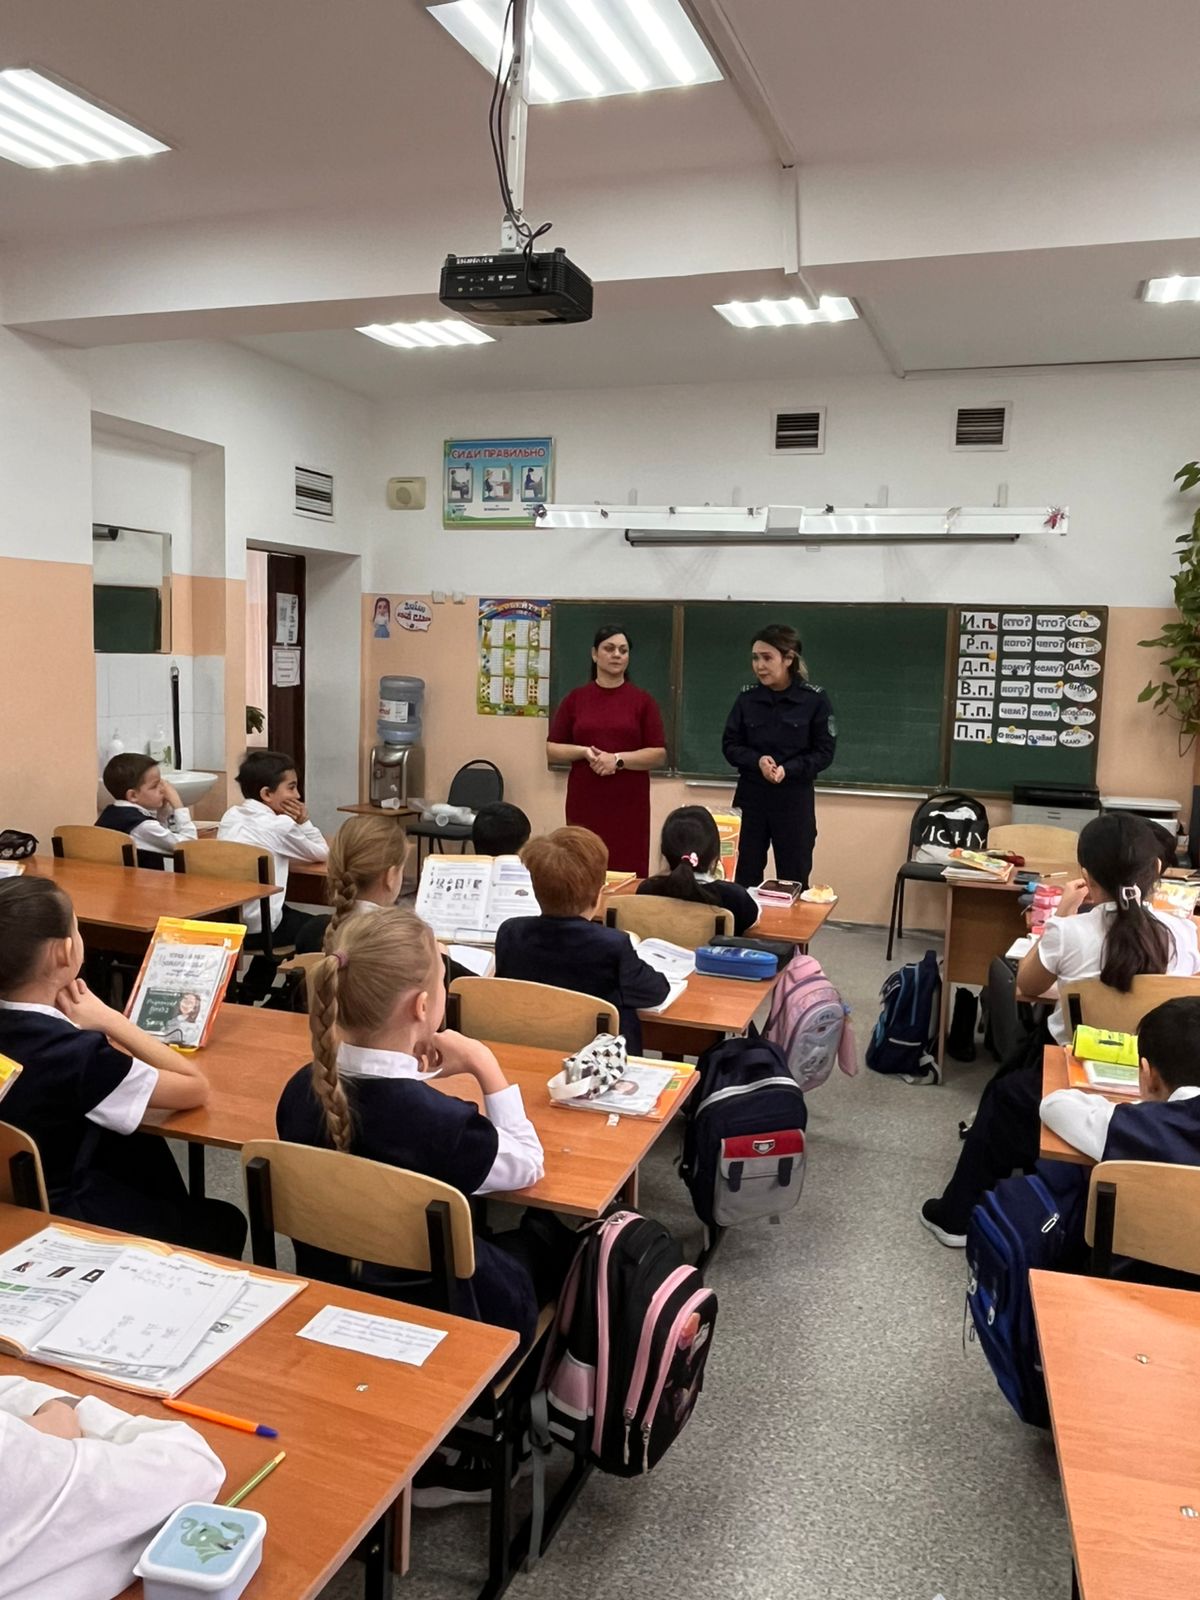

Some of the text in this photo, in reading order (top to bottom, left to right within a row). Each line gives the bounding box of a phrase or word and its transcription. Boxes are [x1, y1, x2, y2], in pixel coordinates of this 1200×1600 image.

[452, 448, 545, 459] СИДИ ПРАВИЛЬНО
[963, 614, 995, 629] И.п
[1003, 616, 1031, 627] кто?
[1037, 617, 1066, 628] что?
[1067, 618, 1089, 628] ЕСТЬ
[966, 637, 993, 650] Р.п.
[1003, 638, 1032, 648] кого?
[1068, 641, 1086, 649] НЕТ
[961, 660, 994, 675] Д.п.
[1067, 663, 1090, 672] ДАМ
[961, 681, 993, 696] В.п.
[959, 702, 991, 717] Т.п.
[957, 724, 991, 739] П.п.
